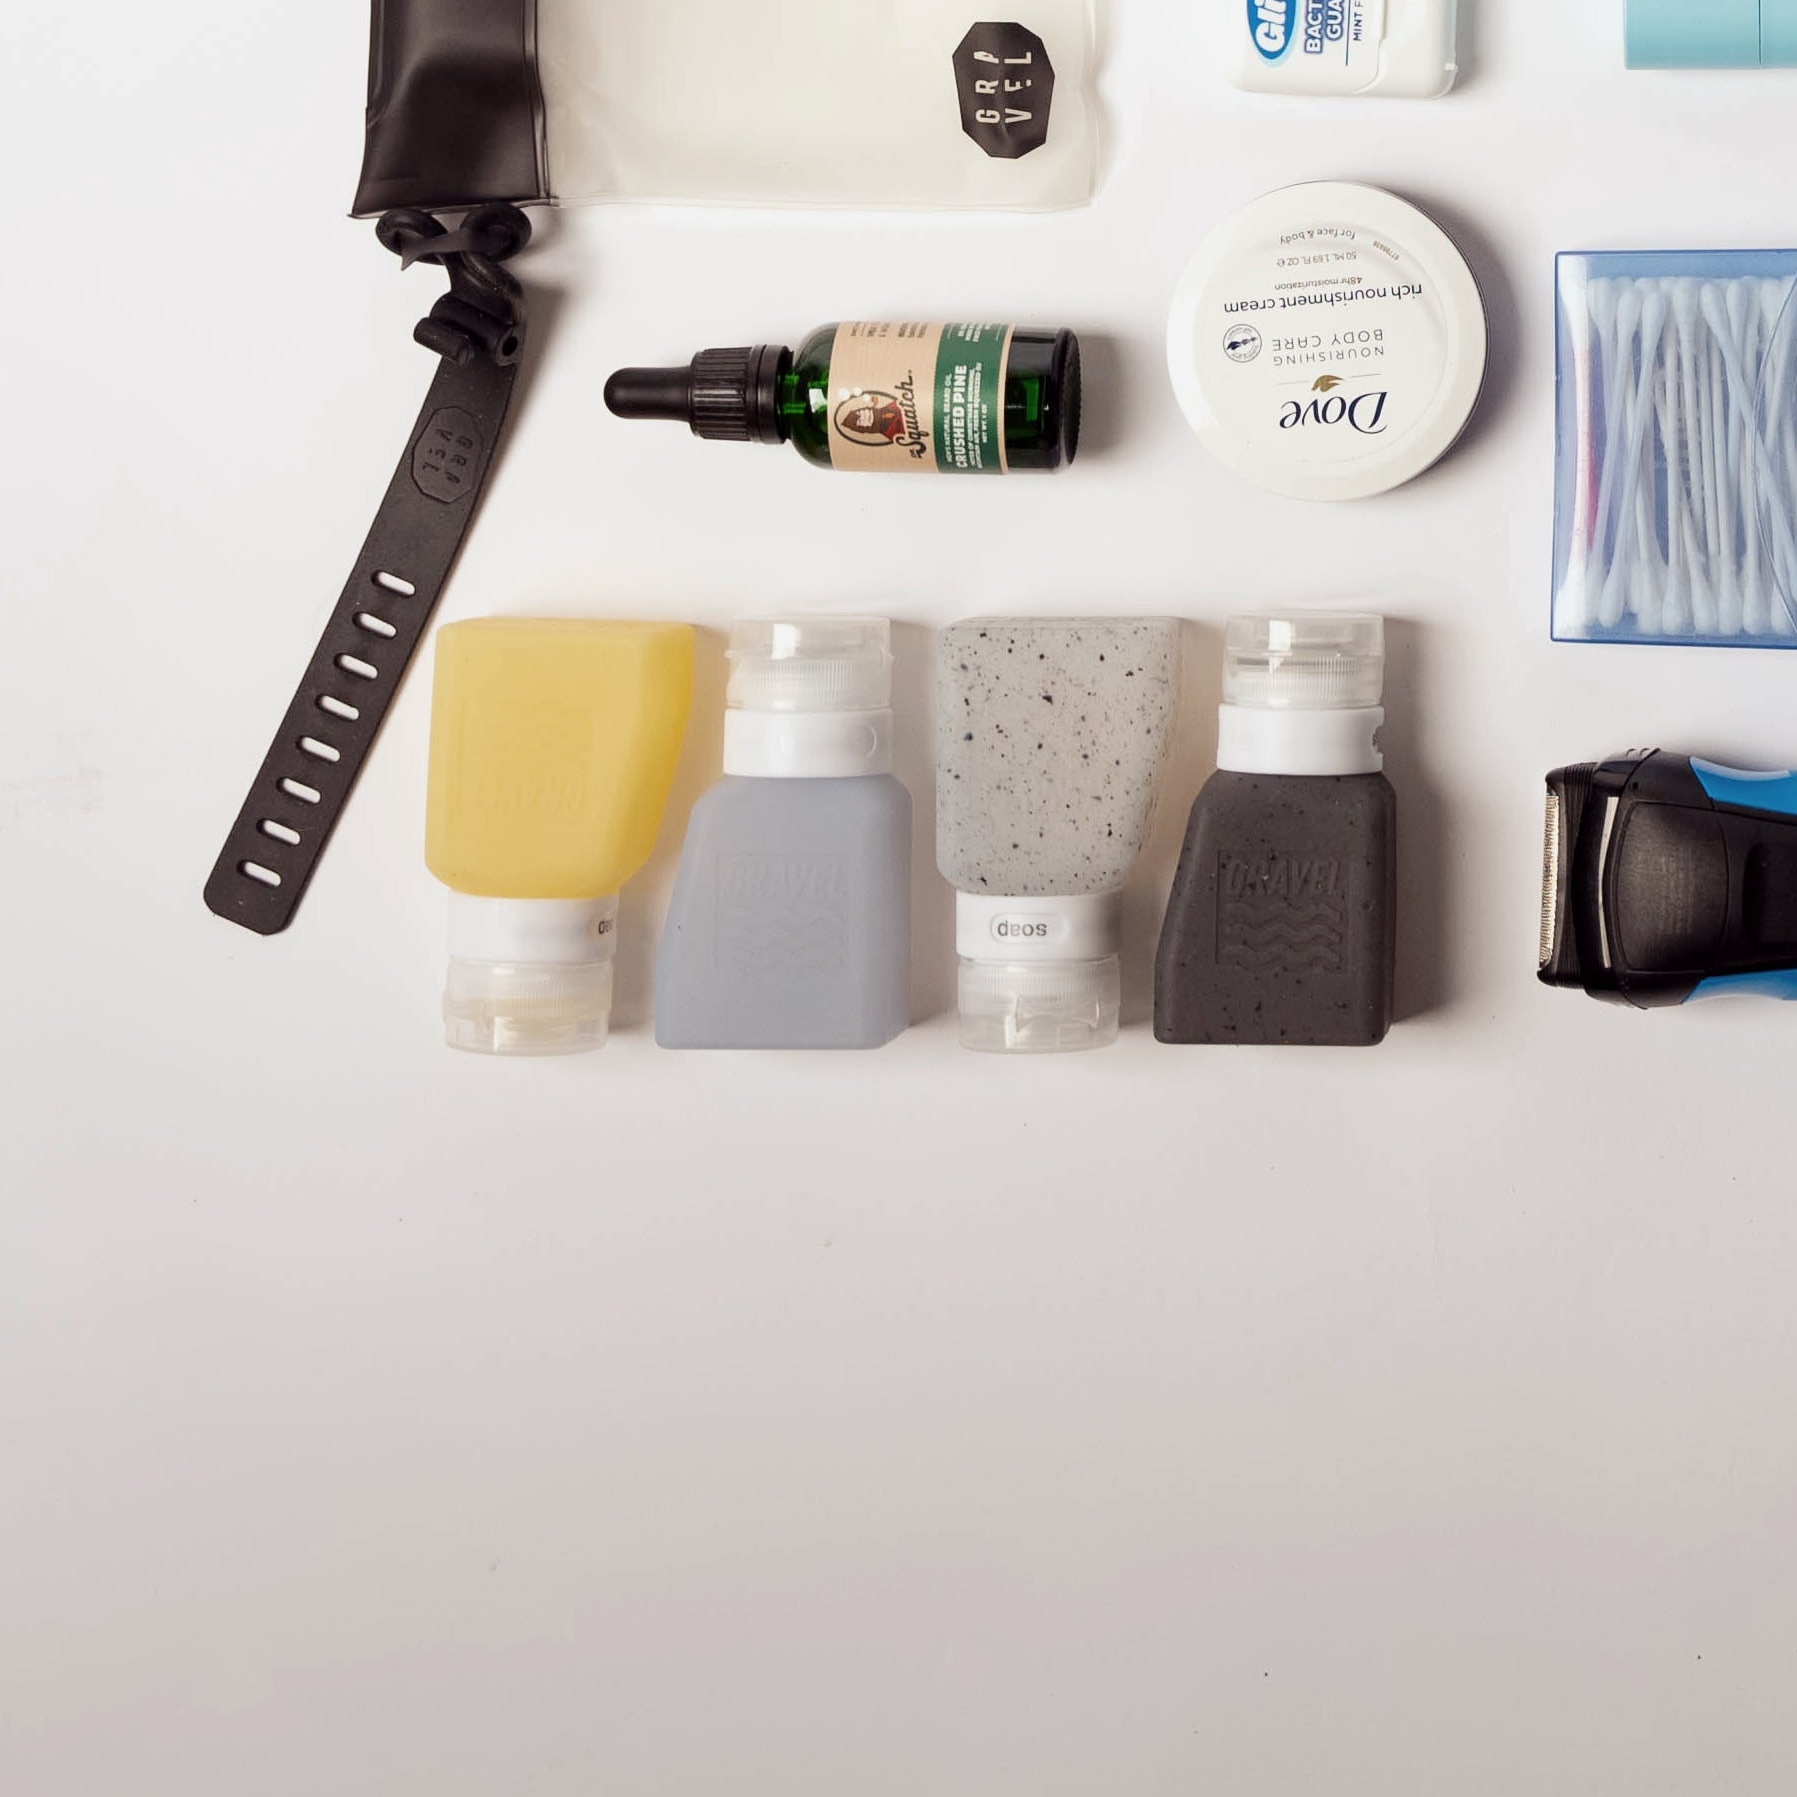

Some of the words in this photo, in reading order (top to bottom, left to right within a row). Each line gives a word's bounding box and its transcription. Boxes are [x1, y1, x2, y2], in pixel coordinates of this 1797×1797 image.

[1352, 12, 1364, 42] MINT
[1278, 231, 1305, 246] body
[1305, 229, 1315, 239] &
[1317, 227, 1339, 241] face
[1340, 228, 1356, 241] for
[1345, 250, 1358, 261] 50
[1274, 278, 1339, 293] moisturization
[1339, 275, 1363, 287] 48hr
[1279, 287, 1387, 310] nourishment
[1391, 283, 1422, 302] rich
[1224, 299, 1276, 316] cream
[1271, 335, 1321, 351] CARE
[1330, 328, 1383, 346] BODY
[1272, 346, 1384, 366] NOURISHING
[953, 364, 967, 404] PINE
[894, 376, 929, 459] Squatch
[1279, 391, 1388, 435] Dove
[952, 406, 968, 468] CRUSHED
[996, 920, 1048, 937] soap
